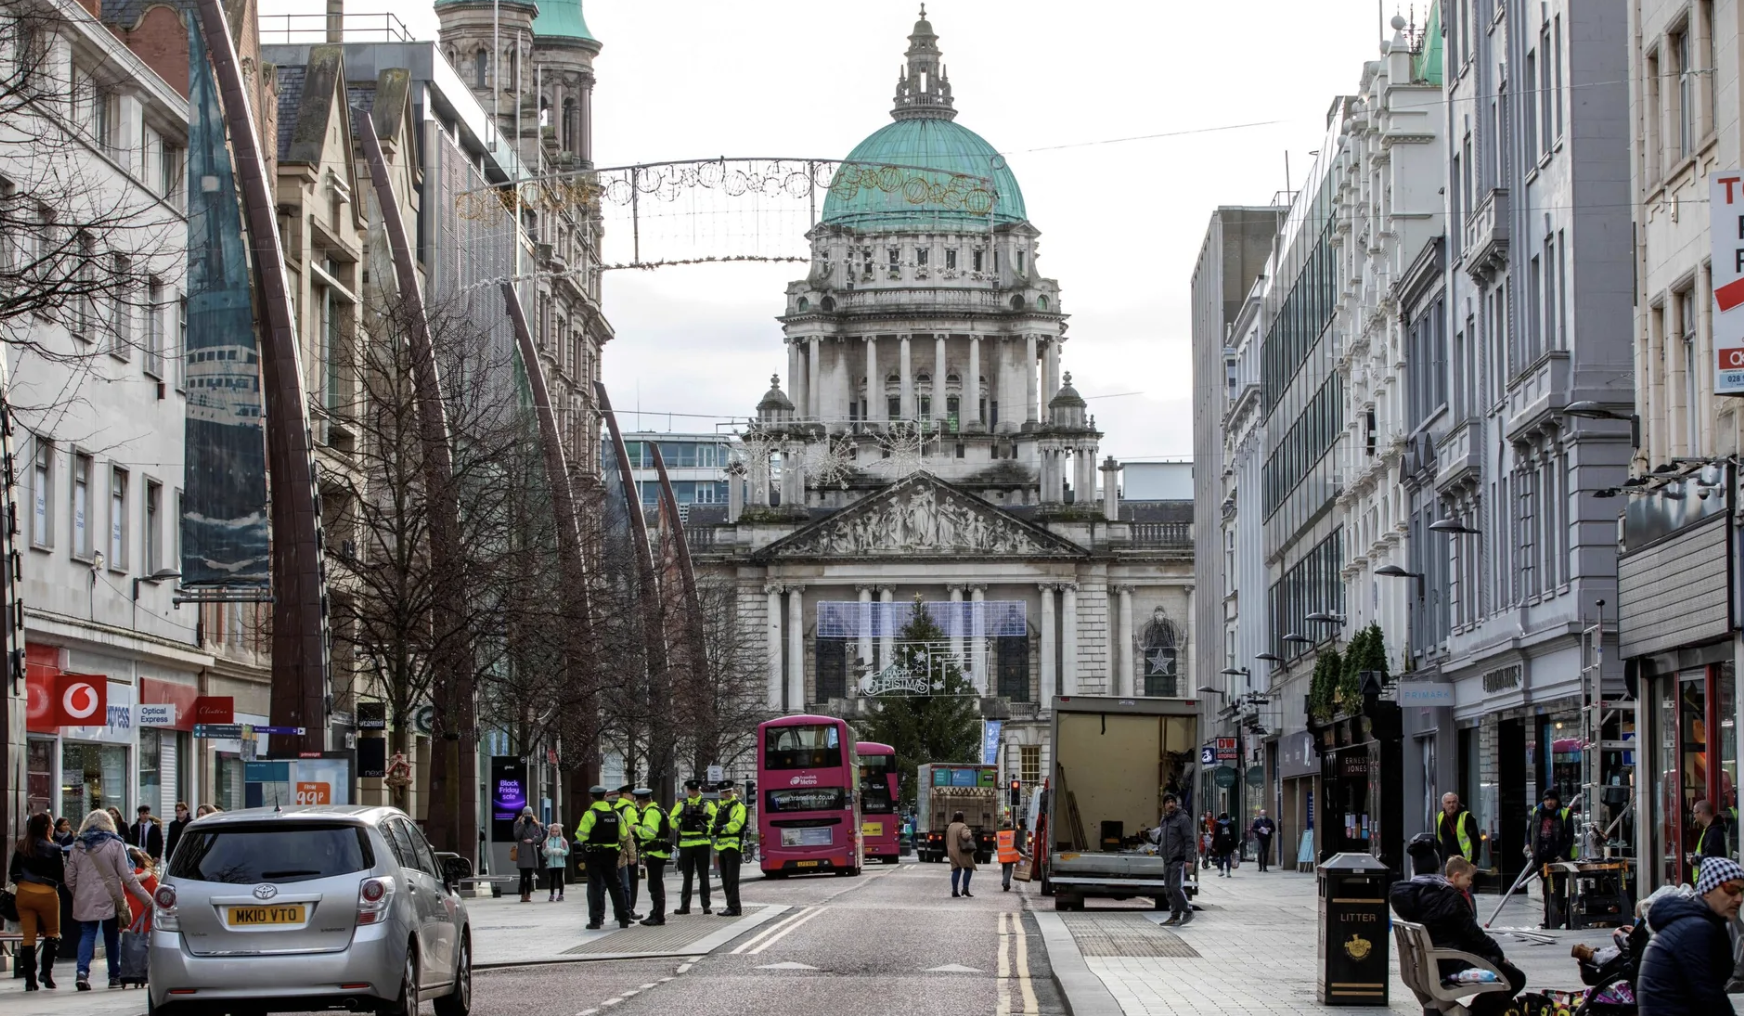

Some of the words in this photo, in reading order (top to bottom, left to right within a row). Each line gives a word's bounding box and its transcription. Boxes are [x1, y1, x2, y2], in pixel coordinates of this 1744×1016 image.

[888, 669, 913, 678] HAPPY
[862, 672, 929, 696] CHRISTMAS
[1405, 690, 1451, 699] PRIMARK
[142, 707, 167, 716] Optical
[140, 715, 168, 724] Express
[1218, 738, 1236, 748] DW
[1347, 765, 1368, 773] JONES
[774, 794, 835, 802] www.translink.co.uk
[236, 909, 266, 923] MK10
[1340, 913, 1376, 922] LITTER
